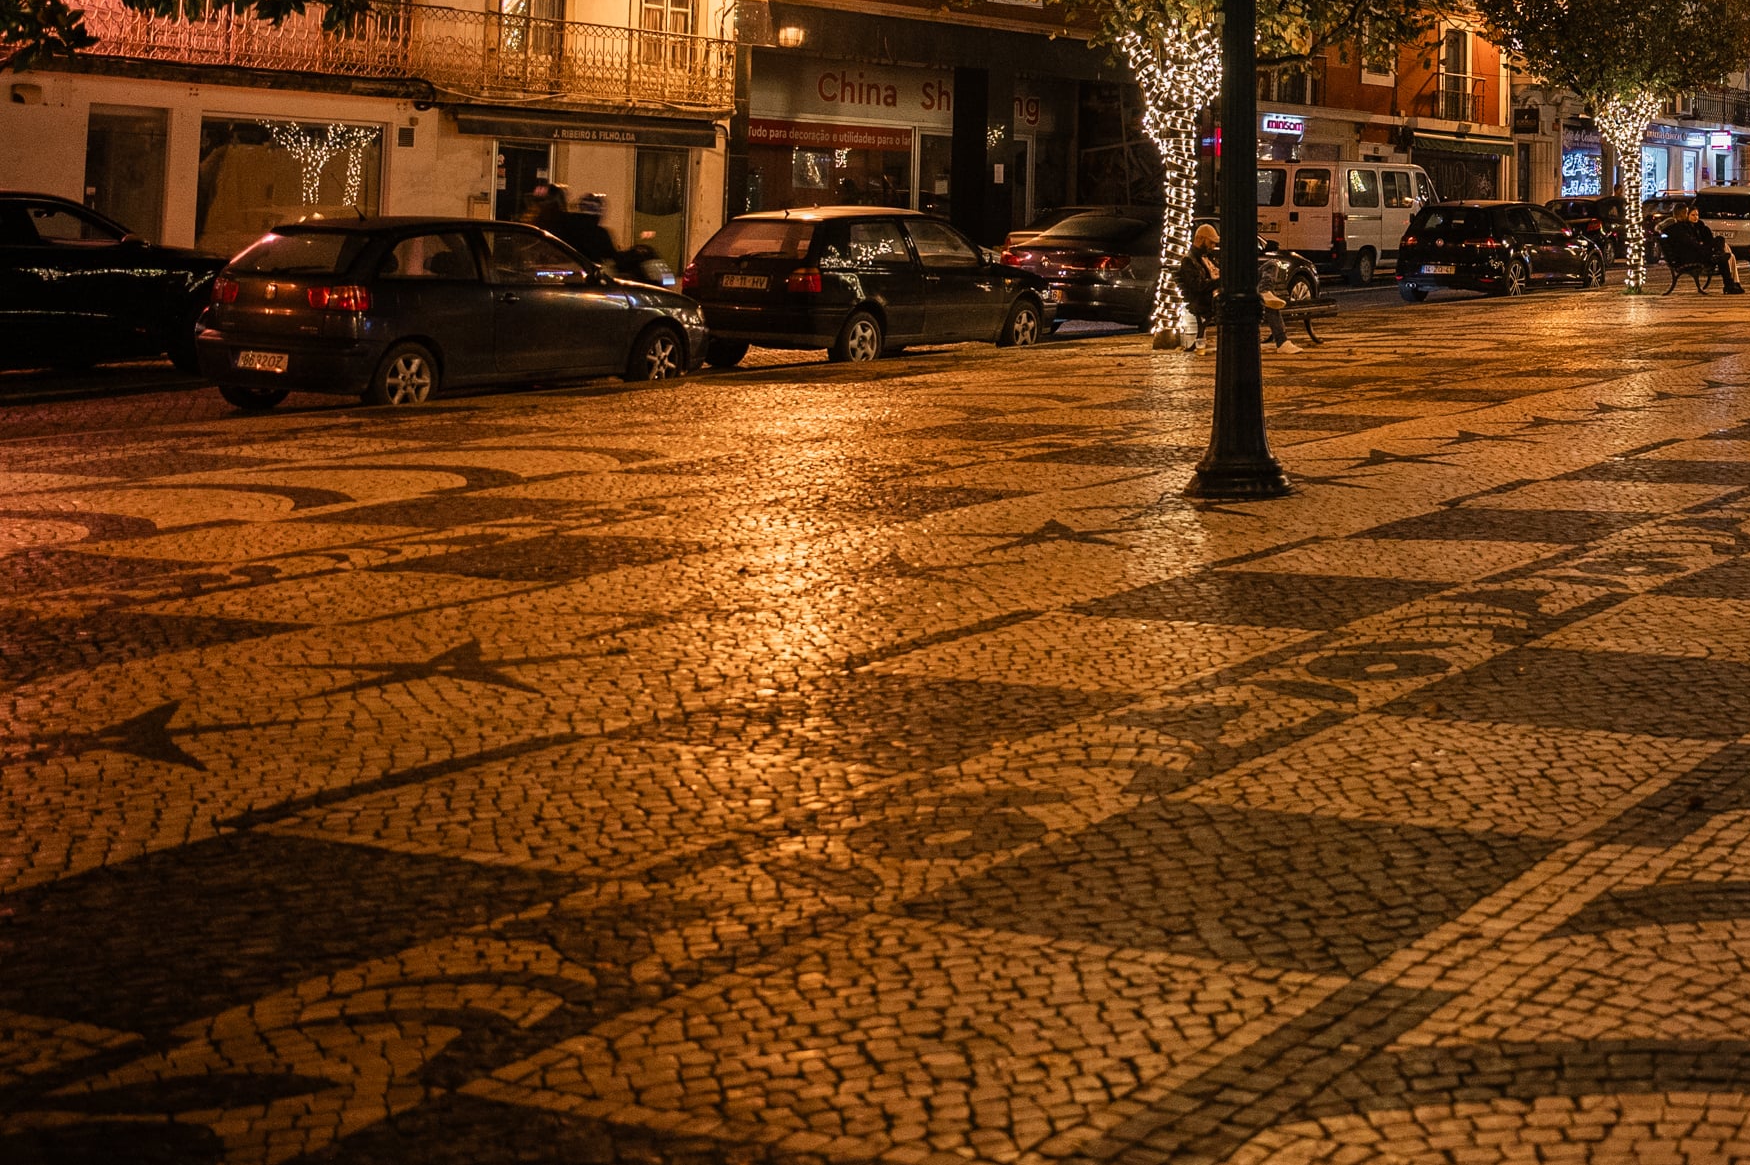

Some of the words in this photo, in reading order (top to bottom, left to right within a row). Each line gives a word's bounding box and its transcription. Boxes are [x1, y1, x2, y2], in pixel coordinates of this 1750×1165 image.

[817, 71, 897, 107] China
[1267, 119, 1303, 132] minisom
[553, 129, 560, 138] J.
[561, 129, 590, 140] RIBEIRO
[748, 126, 767, 138] Tudo
[769, 129, 787, 140] para
[789, 128, 830, 142] decoração
[832, 133, 837, 141] e
[839, 131, 875, 145] utilidades
[877, 135, 894, 147] para
[895, 137, 900, 145] o
[901, 137, 911, 146] lar
